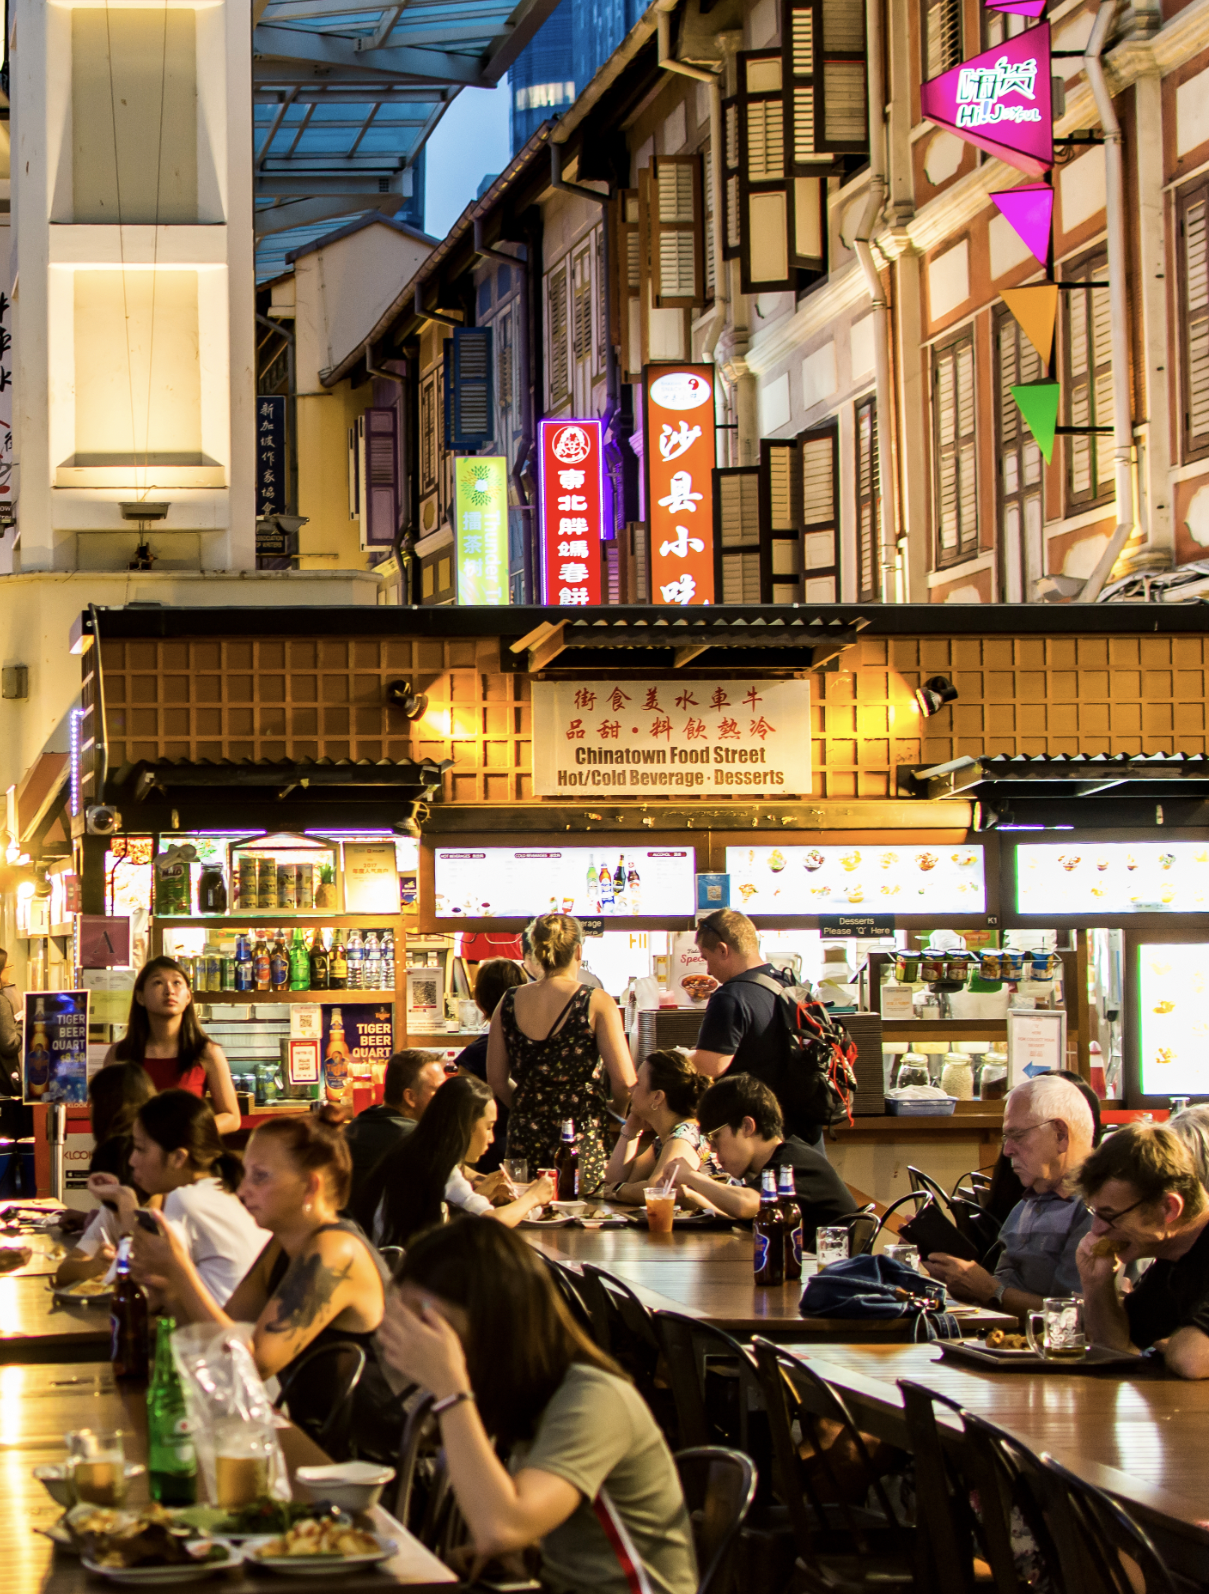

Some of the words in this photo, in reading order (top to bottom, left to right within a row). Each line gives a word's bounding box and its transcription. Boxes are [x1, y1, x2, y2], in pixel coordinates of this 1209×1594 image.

[484, 510, 502, 583] Thunder
[575, 746, 667, 765] Chinatown
[669, 746, 710, 764] Food
[713, 745, 766, 764] Street
[557, 769, 627, 787] Hot/Cold
[629, 769, 704, 788] Beverage
[713, 769, 784, 786] Desserts
[839, 917, 874, 926] Desserts
[824, 927, 851, 935] Please
[871, 927, 890, 935] Here
[57, 1014, 85, 1025] TIGER
[59, 1027, 85, 1038] BEER
[356, 1023, 391, 1034] TIGER
[52, 1040, 85, 1050] QUART
[360, 1035, 391, 1046] BEER
[352, 1047, 392, 1058] QUART
